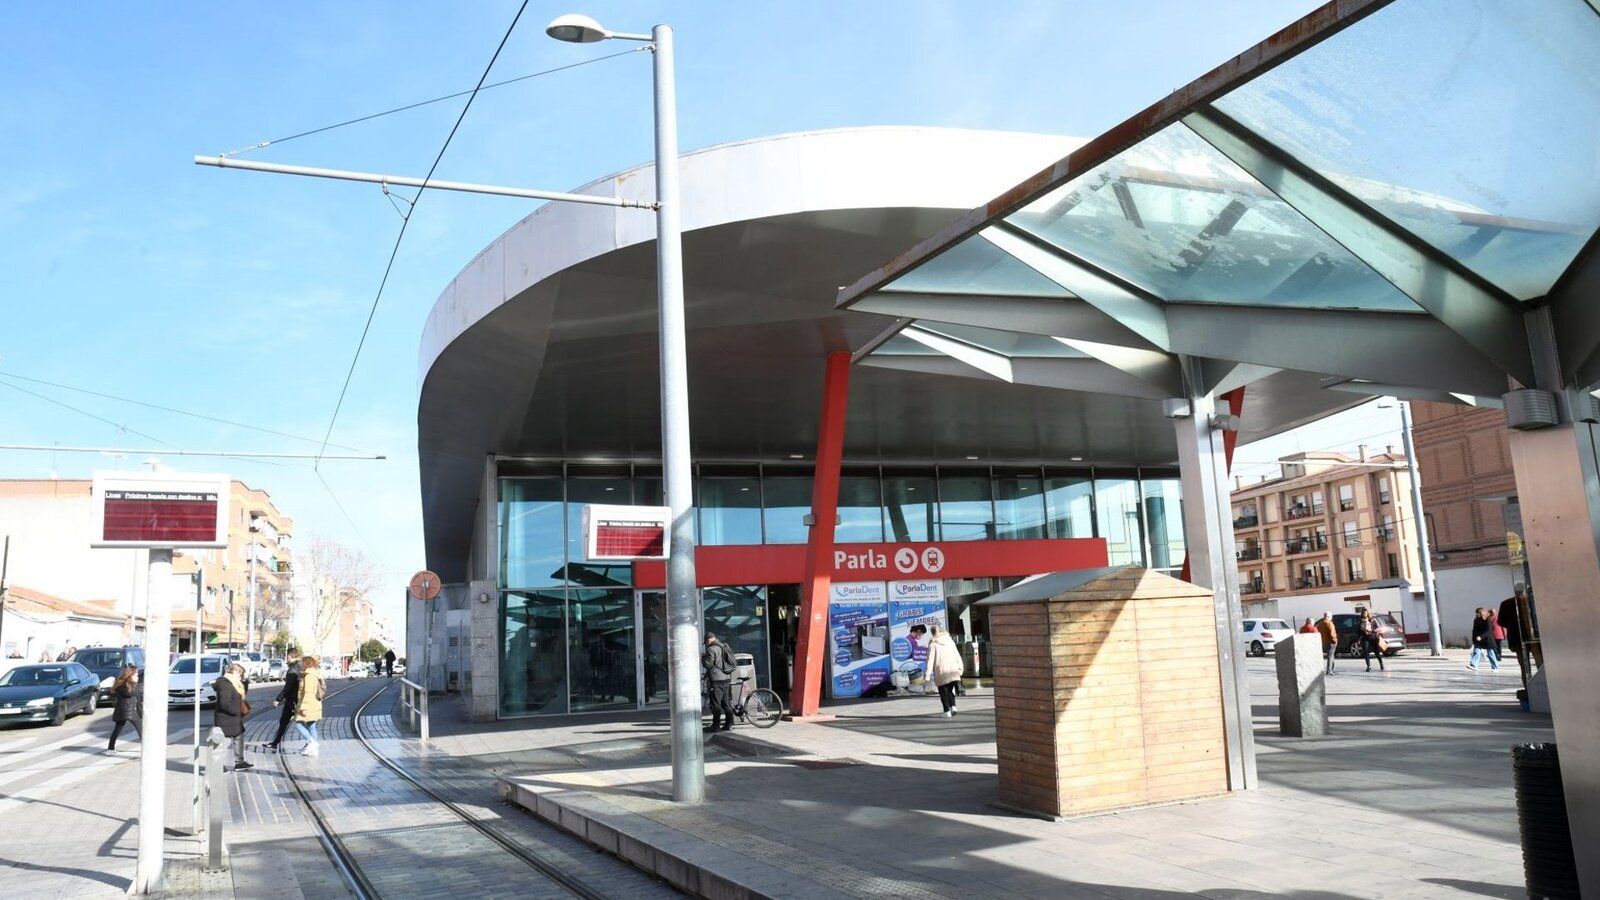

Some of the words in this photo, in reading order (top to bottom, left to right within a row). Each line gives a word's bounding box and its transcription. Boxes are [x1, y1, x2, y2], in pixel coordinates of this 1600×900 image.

[834, 549, 887, 569] Parla
[843, 585, 880, 594] ParlaDent
[902, 583, 938, 592] ParlaDent
